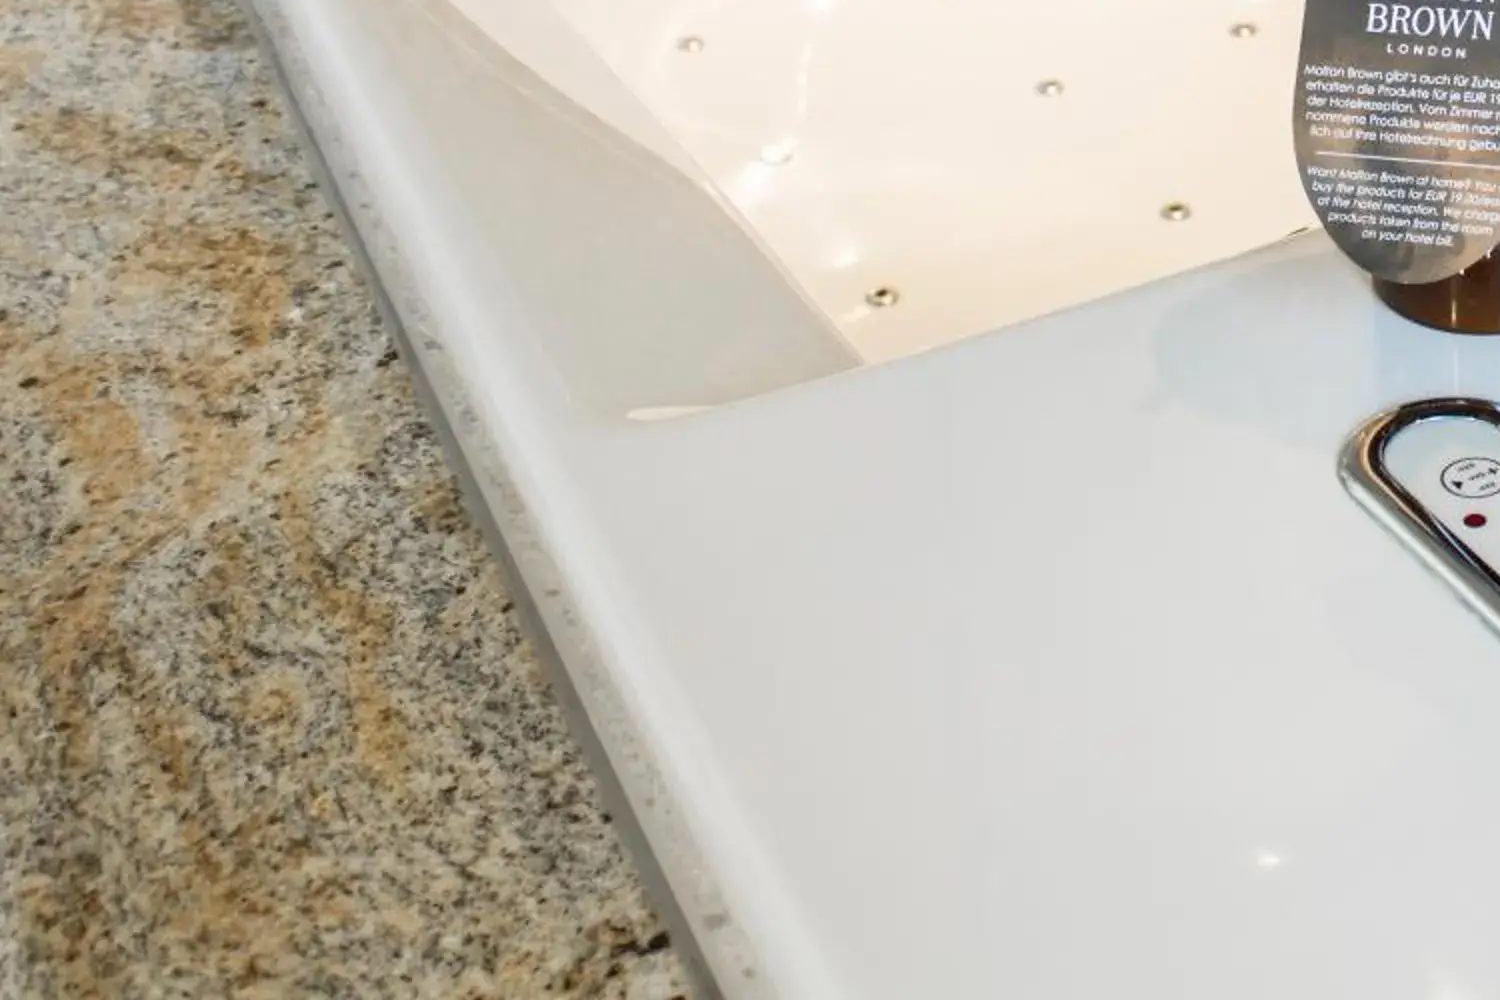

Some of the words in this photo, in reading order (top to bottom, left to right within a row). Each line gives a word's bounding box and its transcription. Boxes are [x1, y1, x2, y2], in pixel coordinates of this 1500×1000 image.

[1366, 3, 1495, 40] BROWN
[1386, 43, 1467, 58] LONDON
[1304, 64, 1345, 77] Molton
[1347, 66, 1383, 80] Brown
[1420, 73, 1451, 85] auch
[1453, 74, 1469, 87] für
[1305, 80, 1354, 93] erhalten
[1357, 83, 1375, 95] die
[1378, 84, 1430, 99] Produkte
[1432, 87, 1448, 101] für
[1449, 91, 1461, 103] je
[1463, 91, 1487, 104] EUR
[1307, 95, 1327, 107] der
[1419, 103, 1447, 116] Vom
[1449, 105, 1493, 119] Zimmer
[1305, 111, 1367, 125] nommene
[1369, 114, 1421, 129] Produkte
[1423, 120, 1469, 133] werden
[1310, 124, 1331, 137] lich
[1333, 127, 1354, 139] auf
[1380, 132, 1467, 150] Hotelrechnung
[1379, 171, 1414, 184] Brown
[1416, 175, 1430, 186] at
[1311, 180, 1333, 193] buy
[1335, 183, 1355, 195] the
[1356, 185, 1406, 199] products
[1408, 187, 1425, 199] for
[1425, 189, 1448, 203] EUR
[1317, 196, 1331, 207] at
[1331, 196, 1351, 208] the
[1352, 199, 1382, 211] hotel
[1327, 211, 1377, 225] products
[1379, 214, 1411, 227] taken
[1413, 217, 1440, 229] from
[1441, 220, 1460, 233] the
[1461, 224, 1494, 237] room
[1361, 229, 1377, 240] on
[1378, 231, 1404, 243] your
[1404, 232, 1435, 245] hotel
